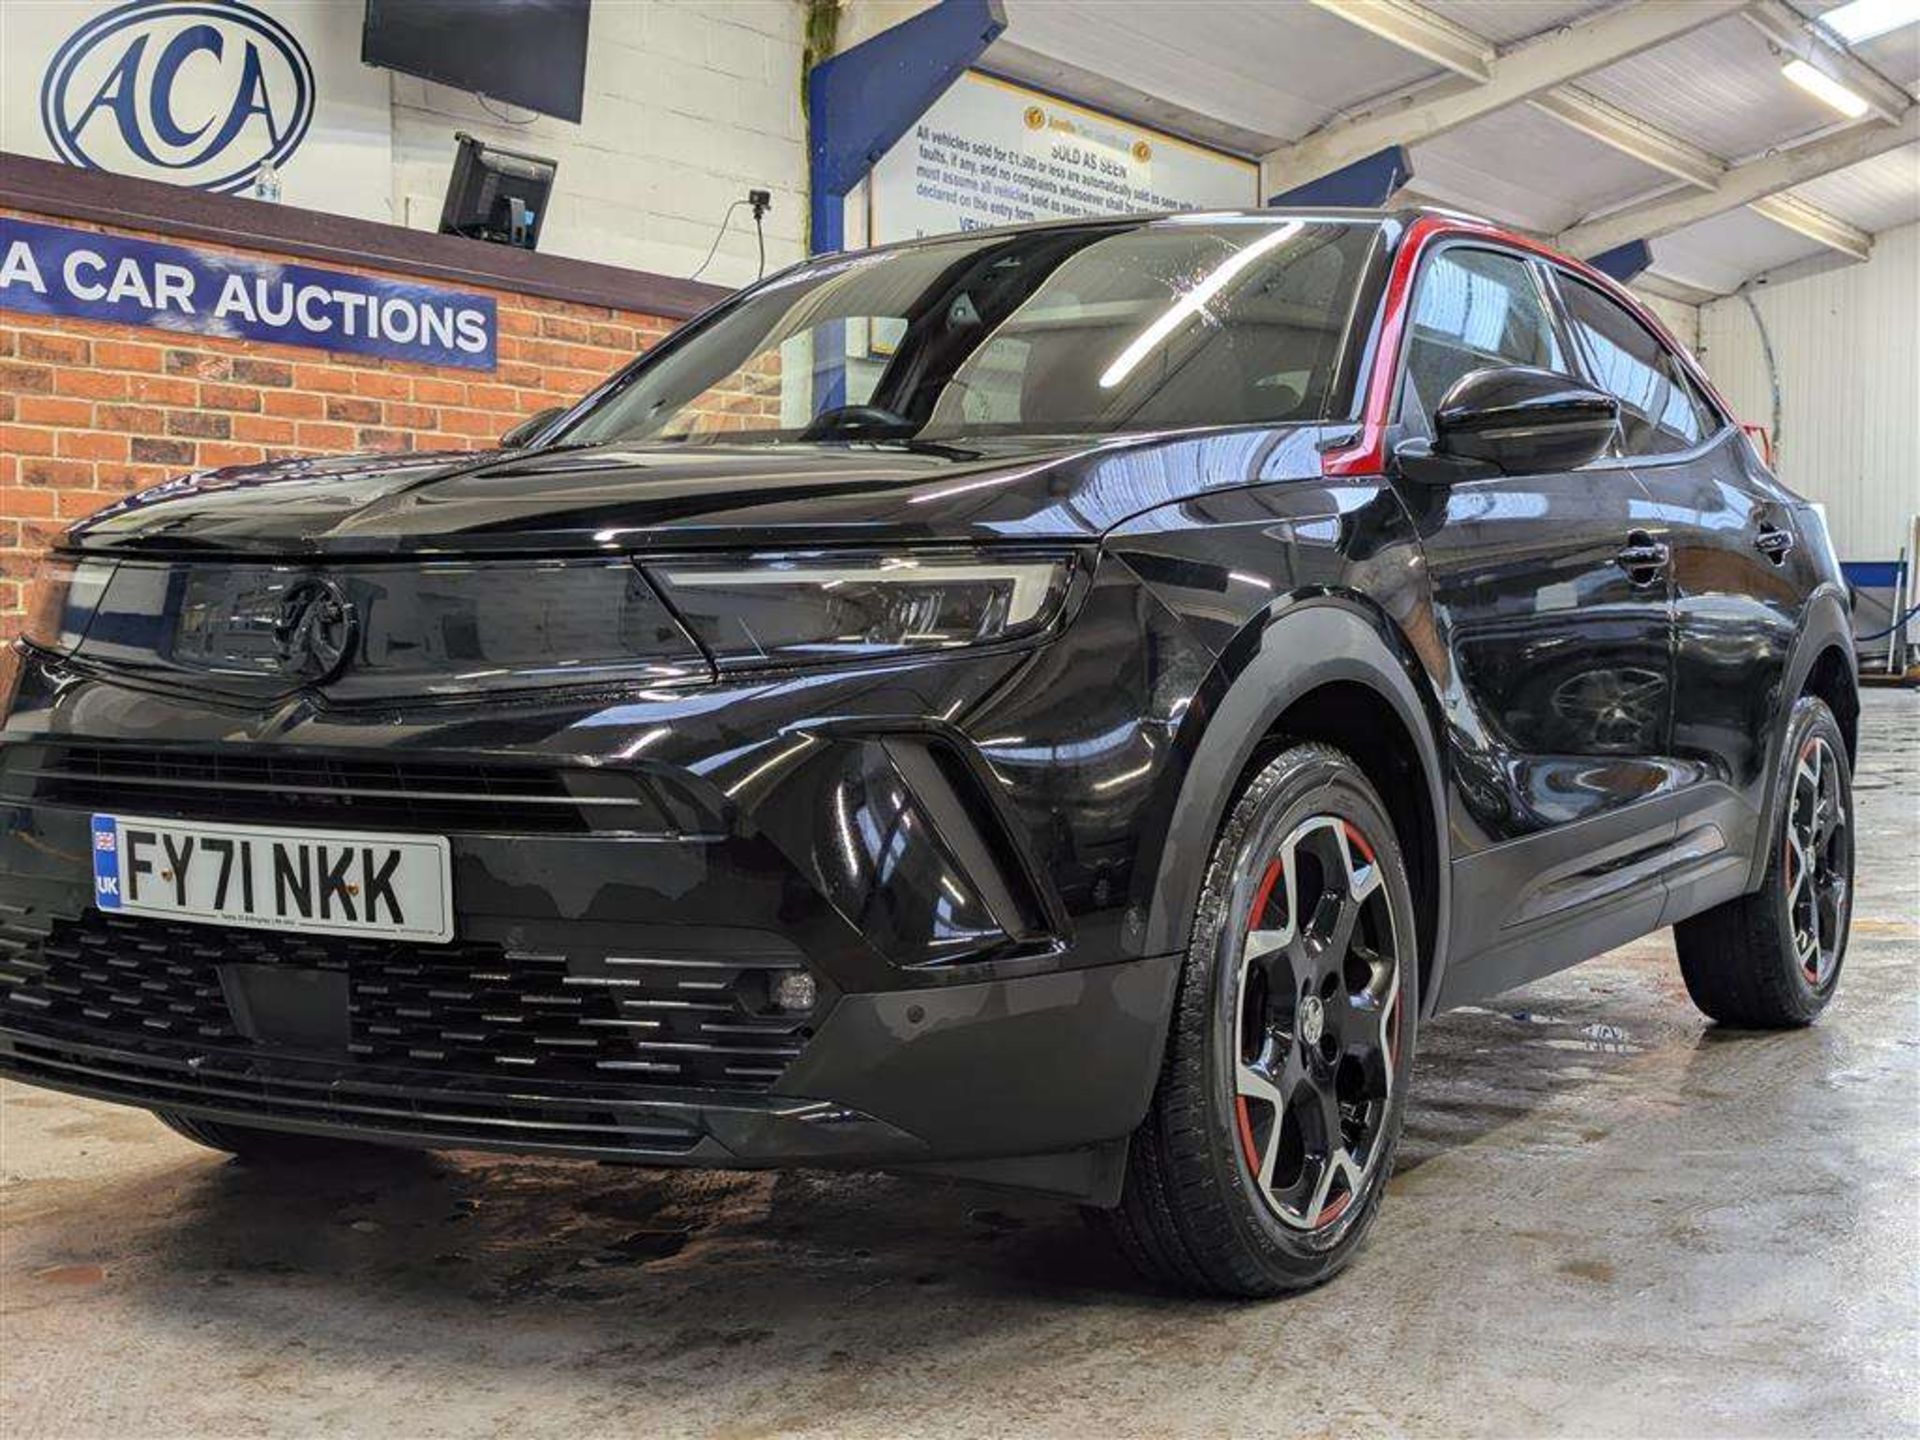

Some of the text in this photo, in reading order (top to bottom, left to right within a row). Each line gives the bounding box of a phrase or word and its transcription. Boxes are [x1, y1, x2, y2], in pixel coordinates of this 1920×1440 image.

[70, 24, 283, 168] ACA
[917, 124, 929, 141] All
[931, 131, 970, 152] vehicles
[972, 142, 993, 158] sold
[993, 146, 1007, 162] for
[1048, 163, 1066, 179] less
[1067, 170, 1080, 184] are
[1081, 173, 1132, 198] automatically
[1133, 187, 1150, 202] sold
[980, 163, 998, 179] and
[999, 168, 1011, 182] no
[1051, 144, 1081, 166] SOLD
[1083, 153, 1098, 171] AS
[916, 183, 957, 204] declared
[959, 194, 972, 209] on
[972, 196, 988, 212] the
[989, 203, 1013, 221] entry
[62, 248, 196, 314] CAR
[214, 273, 489, 354] AUCTIONS
[97, 876, 119, 896] UK
[272, 842, 405, 925] NKK
